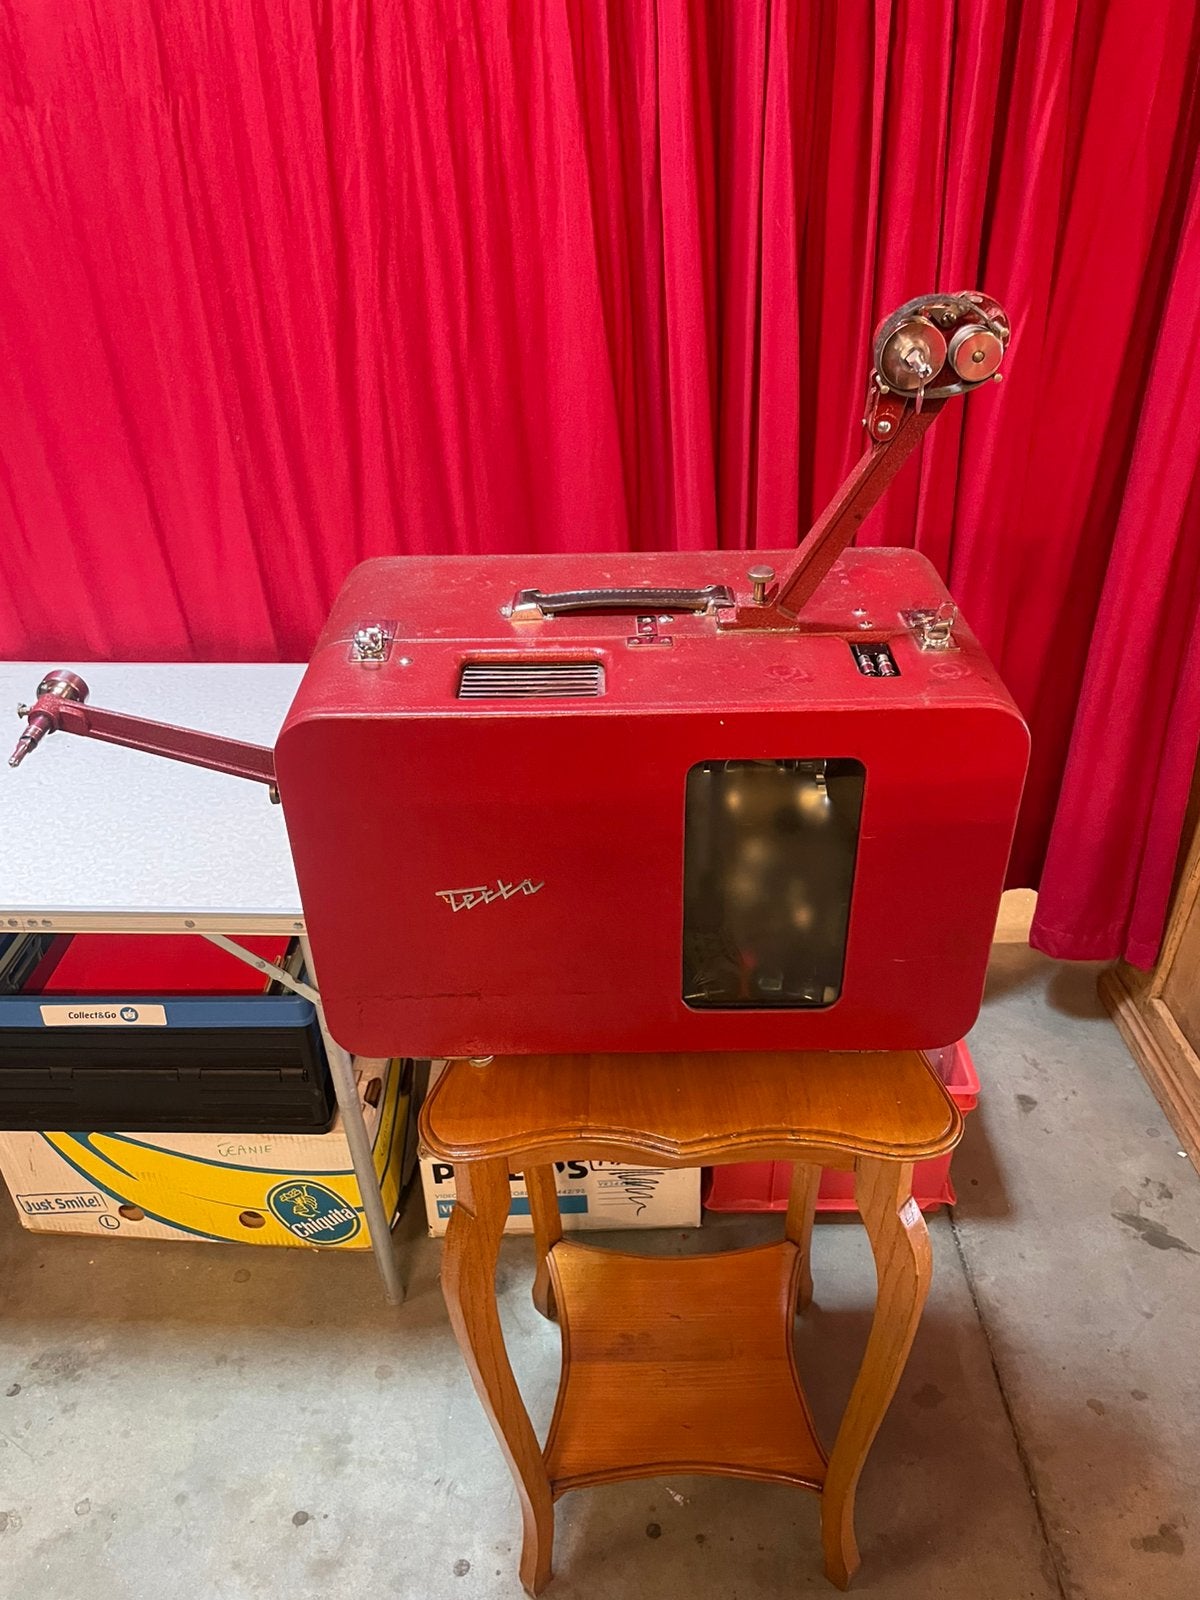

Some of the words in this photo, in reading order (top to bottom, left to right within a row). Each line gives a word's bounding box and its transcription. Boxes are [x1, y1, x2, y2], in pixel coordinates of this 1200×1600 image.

[68, 1011, 117, 1019] Collect&Go
[25, 1198, 55, 1212] Just
[55, 1195, 101, 1210] Smile!
[290, 1206, 357, 1238] Chiquita
